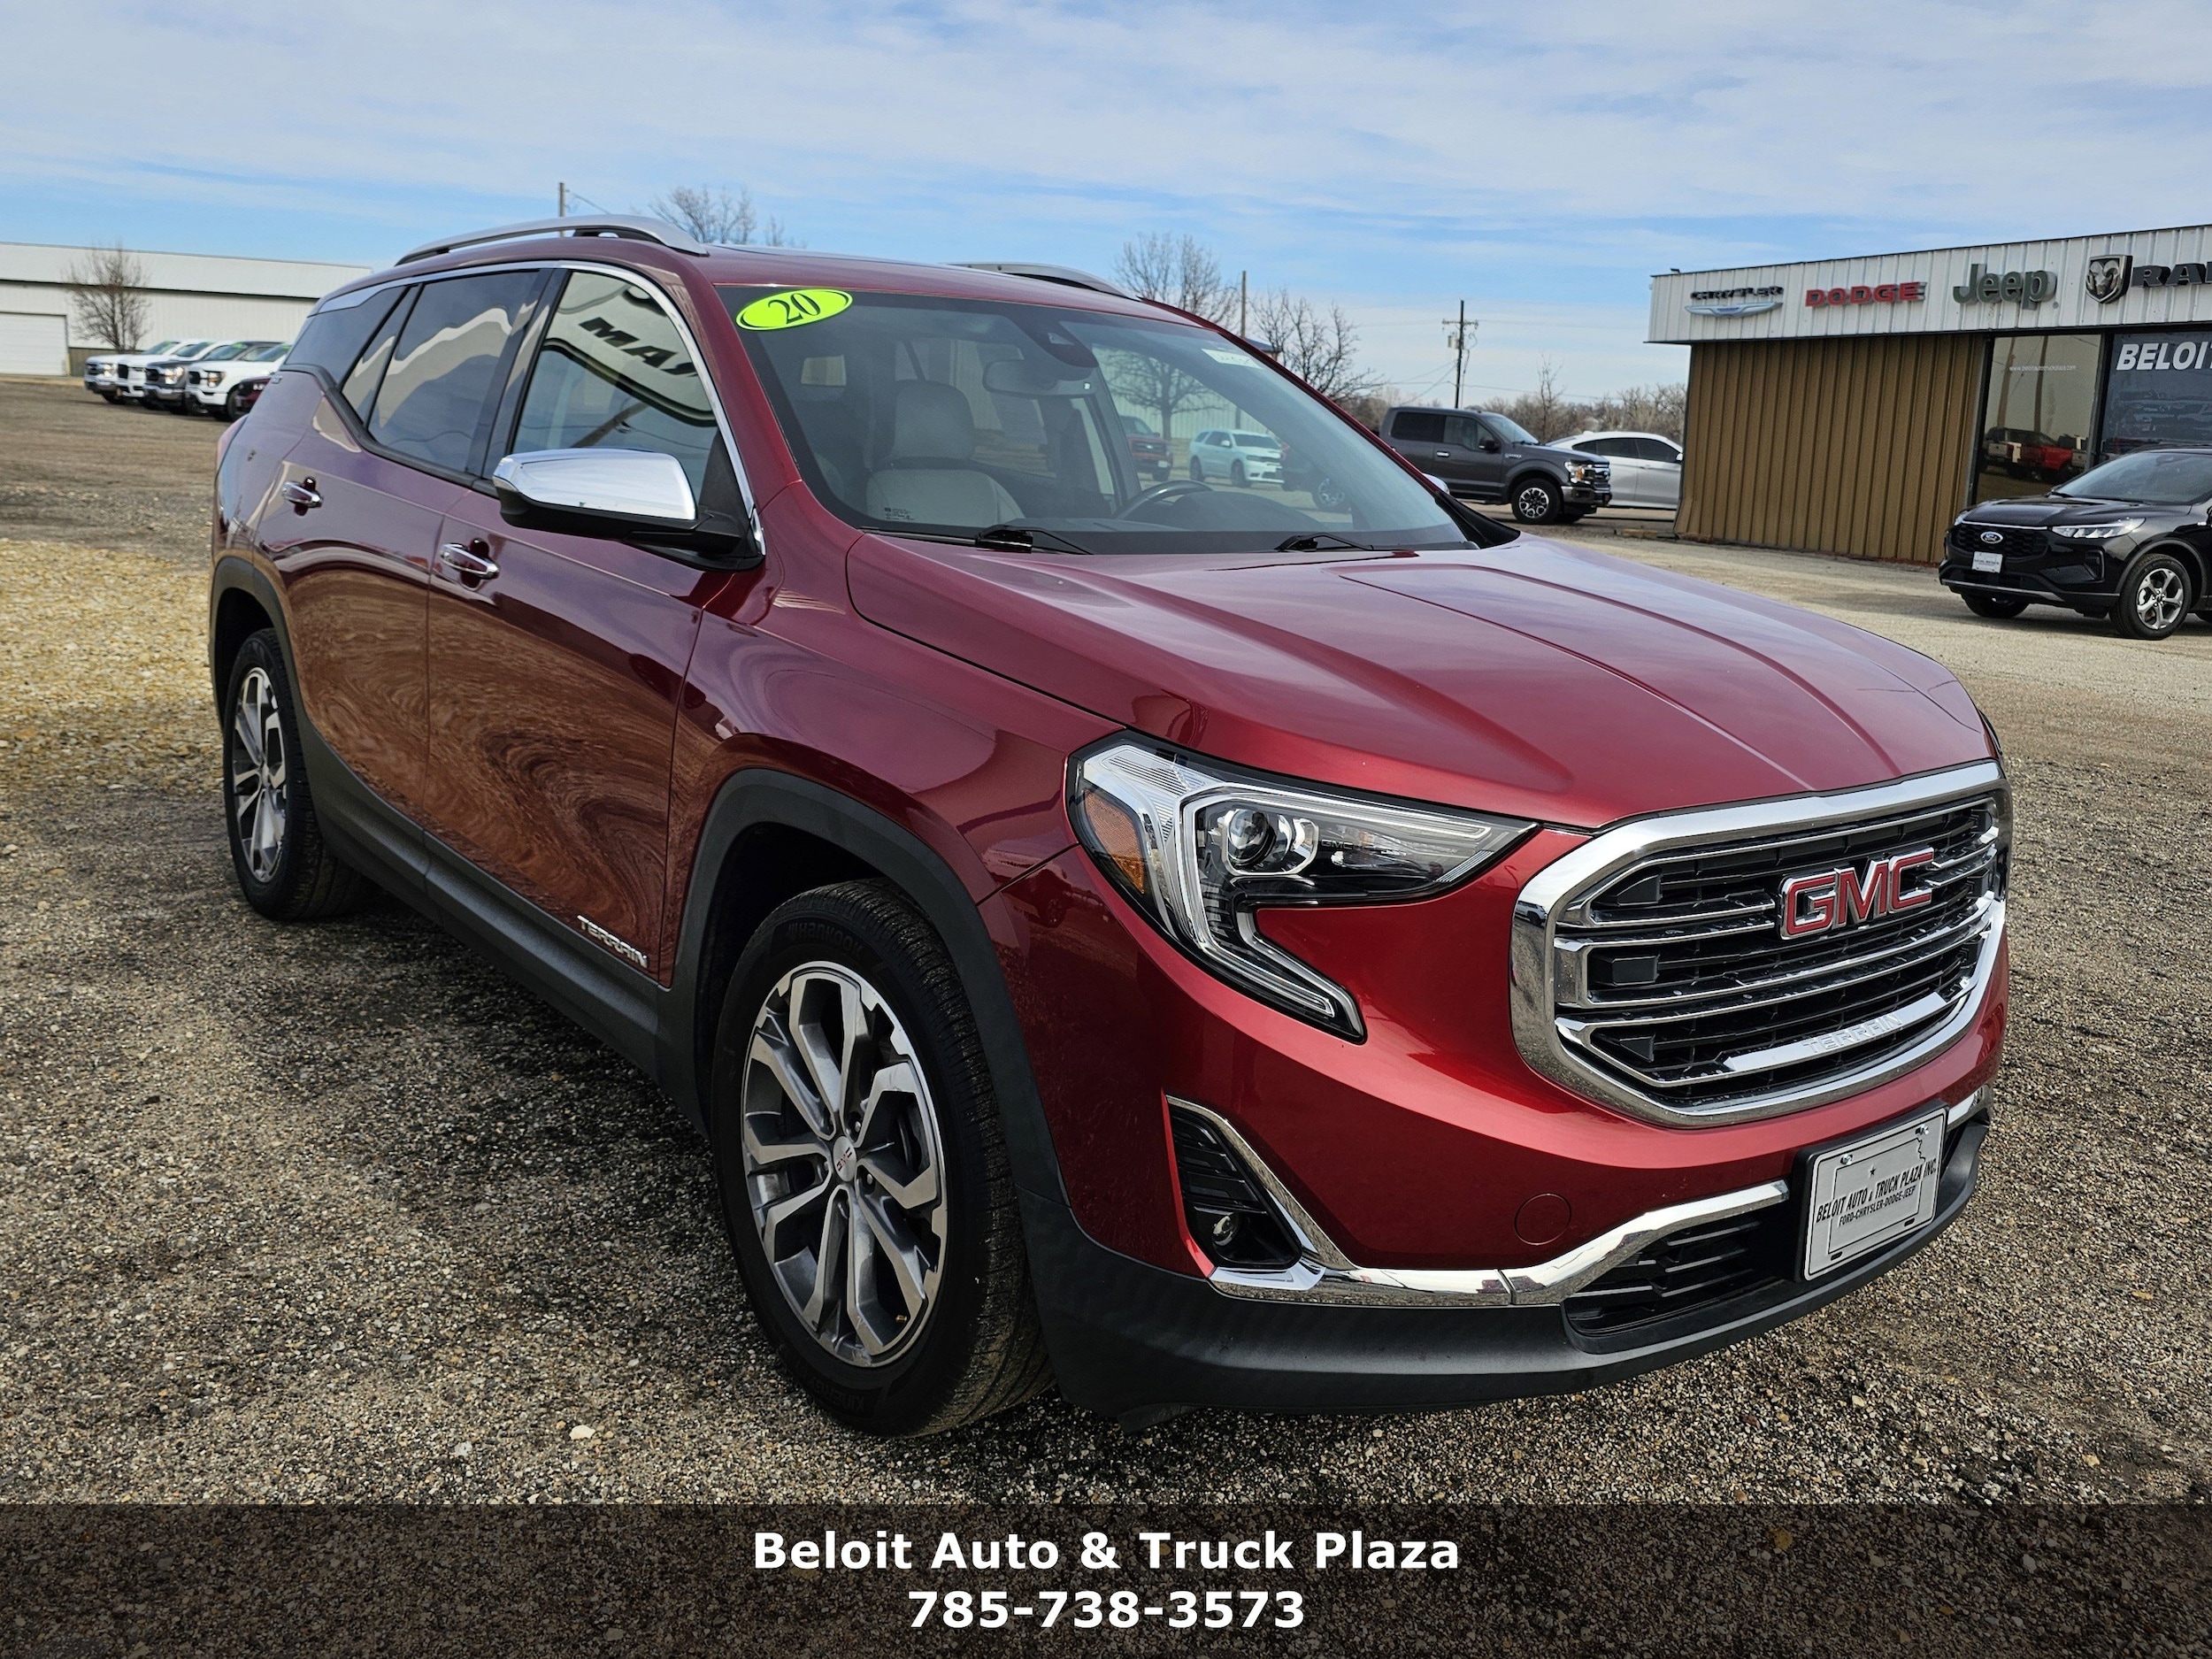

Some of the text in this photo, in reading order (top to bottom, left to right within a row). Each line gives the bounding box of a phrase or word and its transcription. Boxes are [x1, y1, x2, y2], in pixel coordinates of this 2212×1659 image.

[1805, 281, 1927, 307] DODGE
[1953, 264, 2057, 310] Jeep
[2131, 261, 2212, 288] RA
[768, 293, 821, 324] 20
[1321, 839, 1354, 850] GMC
[1780, 847, 1934, 941] GMC
[577, 915, 648, 969] TERRAIN
[1803, 1014, 1902, 1053] TERRAIN
[1816, 1196, 1847, 1223] BELOIT
[1847, 1187, 1869, 1210] AUTO
[1875, 1173, 1901, 1199] TRUCK
[1900, 1164, 1924, 1187] PLAZA
[1924, 1158, 1937, 1178] INC.
